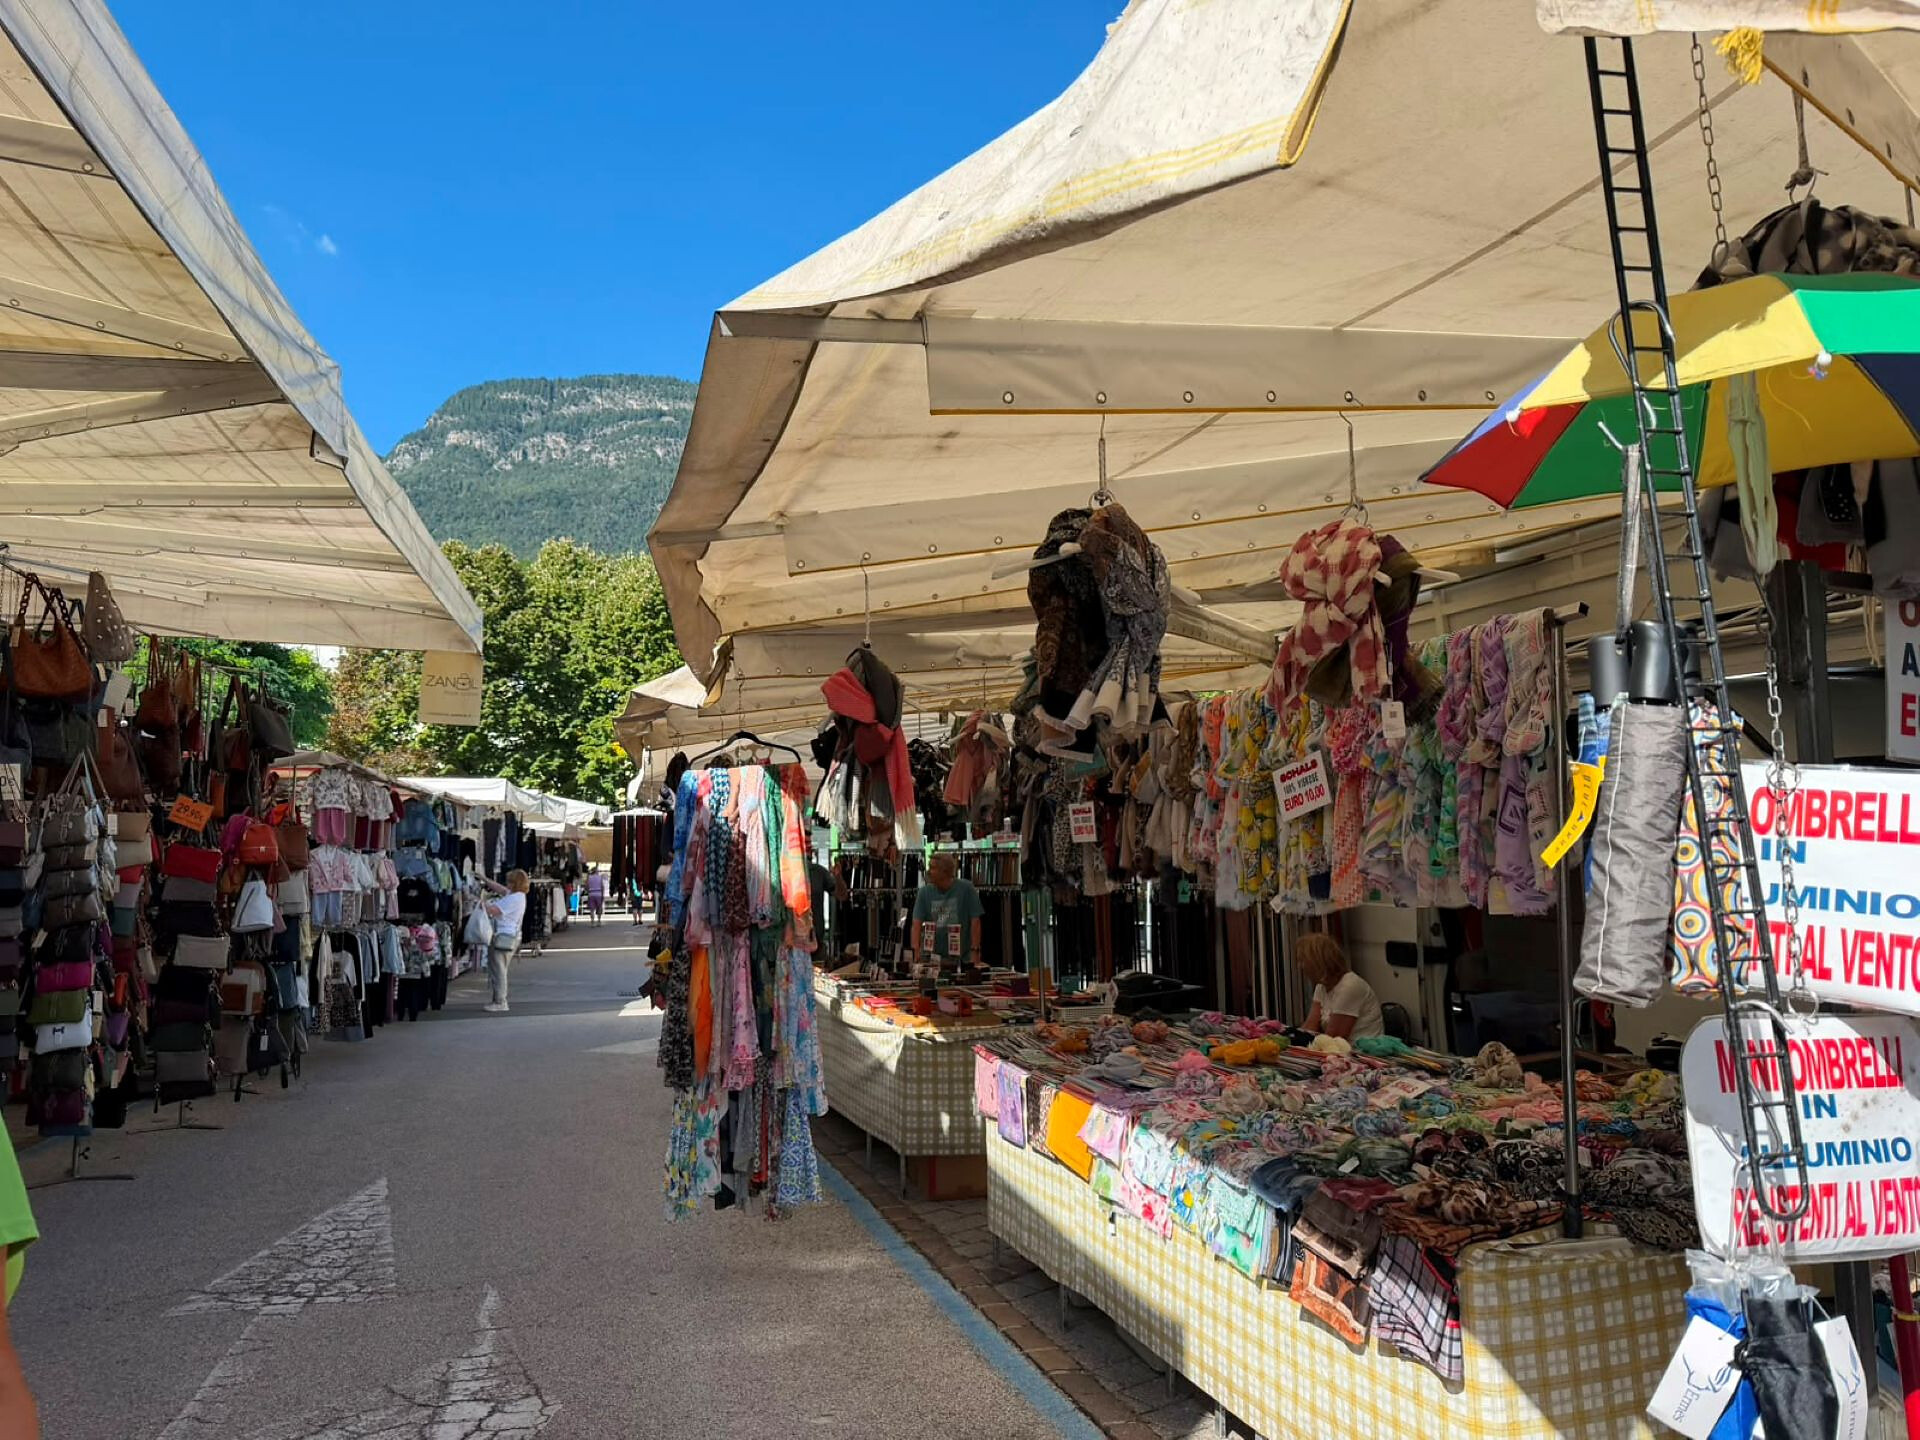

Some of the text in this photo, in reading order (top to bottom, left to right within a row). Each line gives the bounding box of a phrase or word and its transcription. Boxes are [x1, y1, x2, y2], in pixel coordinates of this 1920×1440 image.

[1284, 793, 1304, 812] EURO
[1760, 838, 1807, 864] IN
[1743, 882, 1920, 919] UMINIO
[1714, 1036, 1904, 1093] MNI OMBRELLI
[1802, 1093, 1838, 1119] IN
[1843, 1181, 1868, 1237] AL
